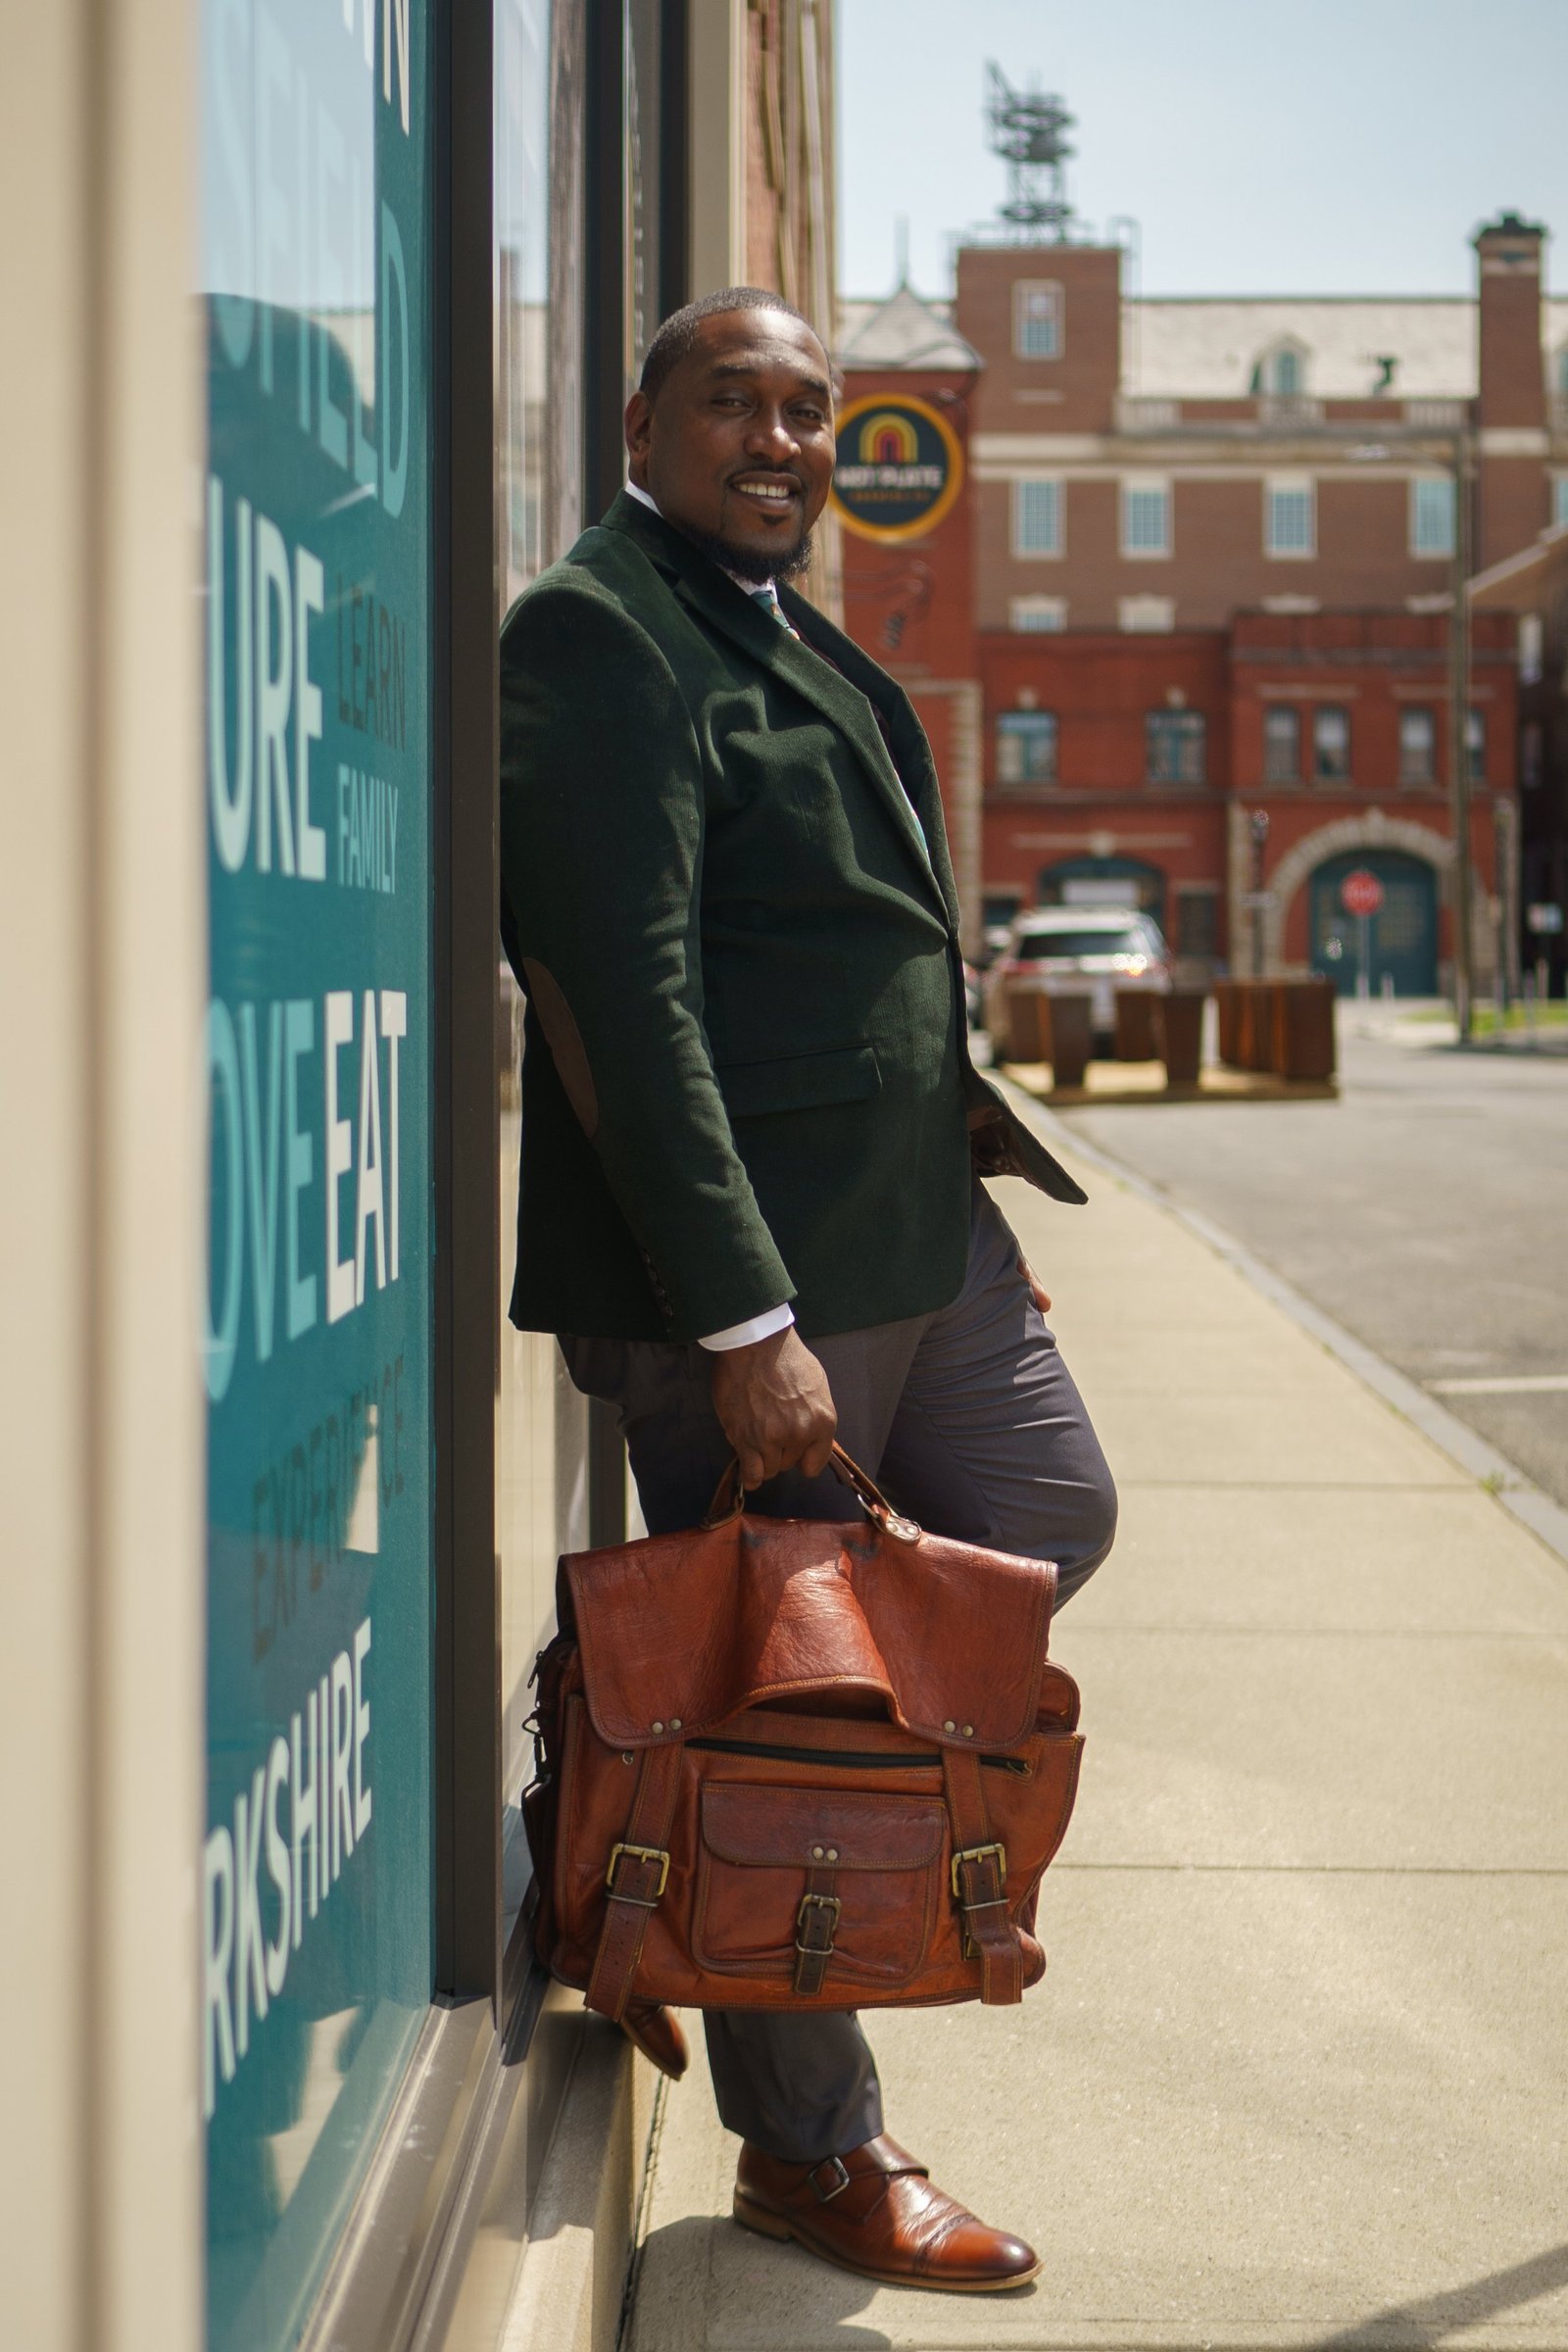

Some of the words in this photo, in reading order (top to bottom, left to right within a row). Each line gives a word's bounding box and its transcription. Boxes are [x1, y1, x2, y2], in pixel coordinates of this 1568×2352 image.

[208, 473, 327, 881] URE
[336, 571, 406, 754] LEARN
[338, 761, 399, 896] FAMILY
[324, 989, 408, 1326] EAT
[204, 1615, 372, 2120] RKSHIRE
